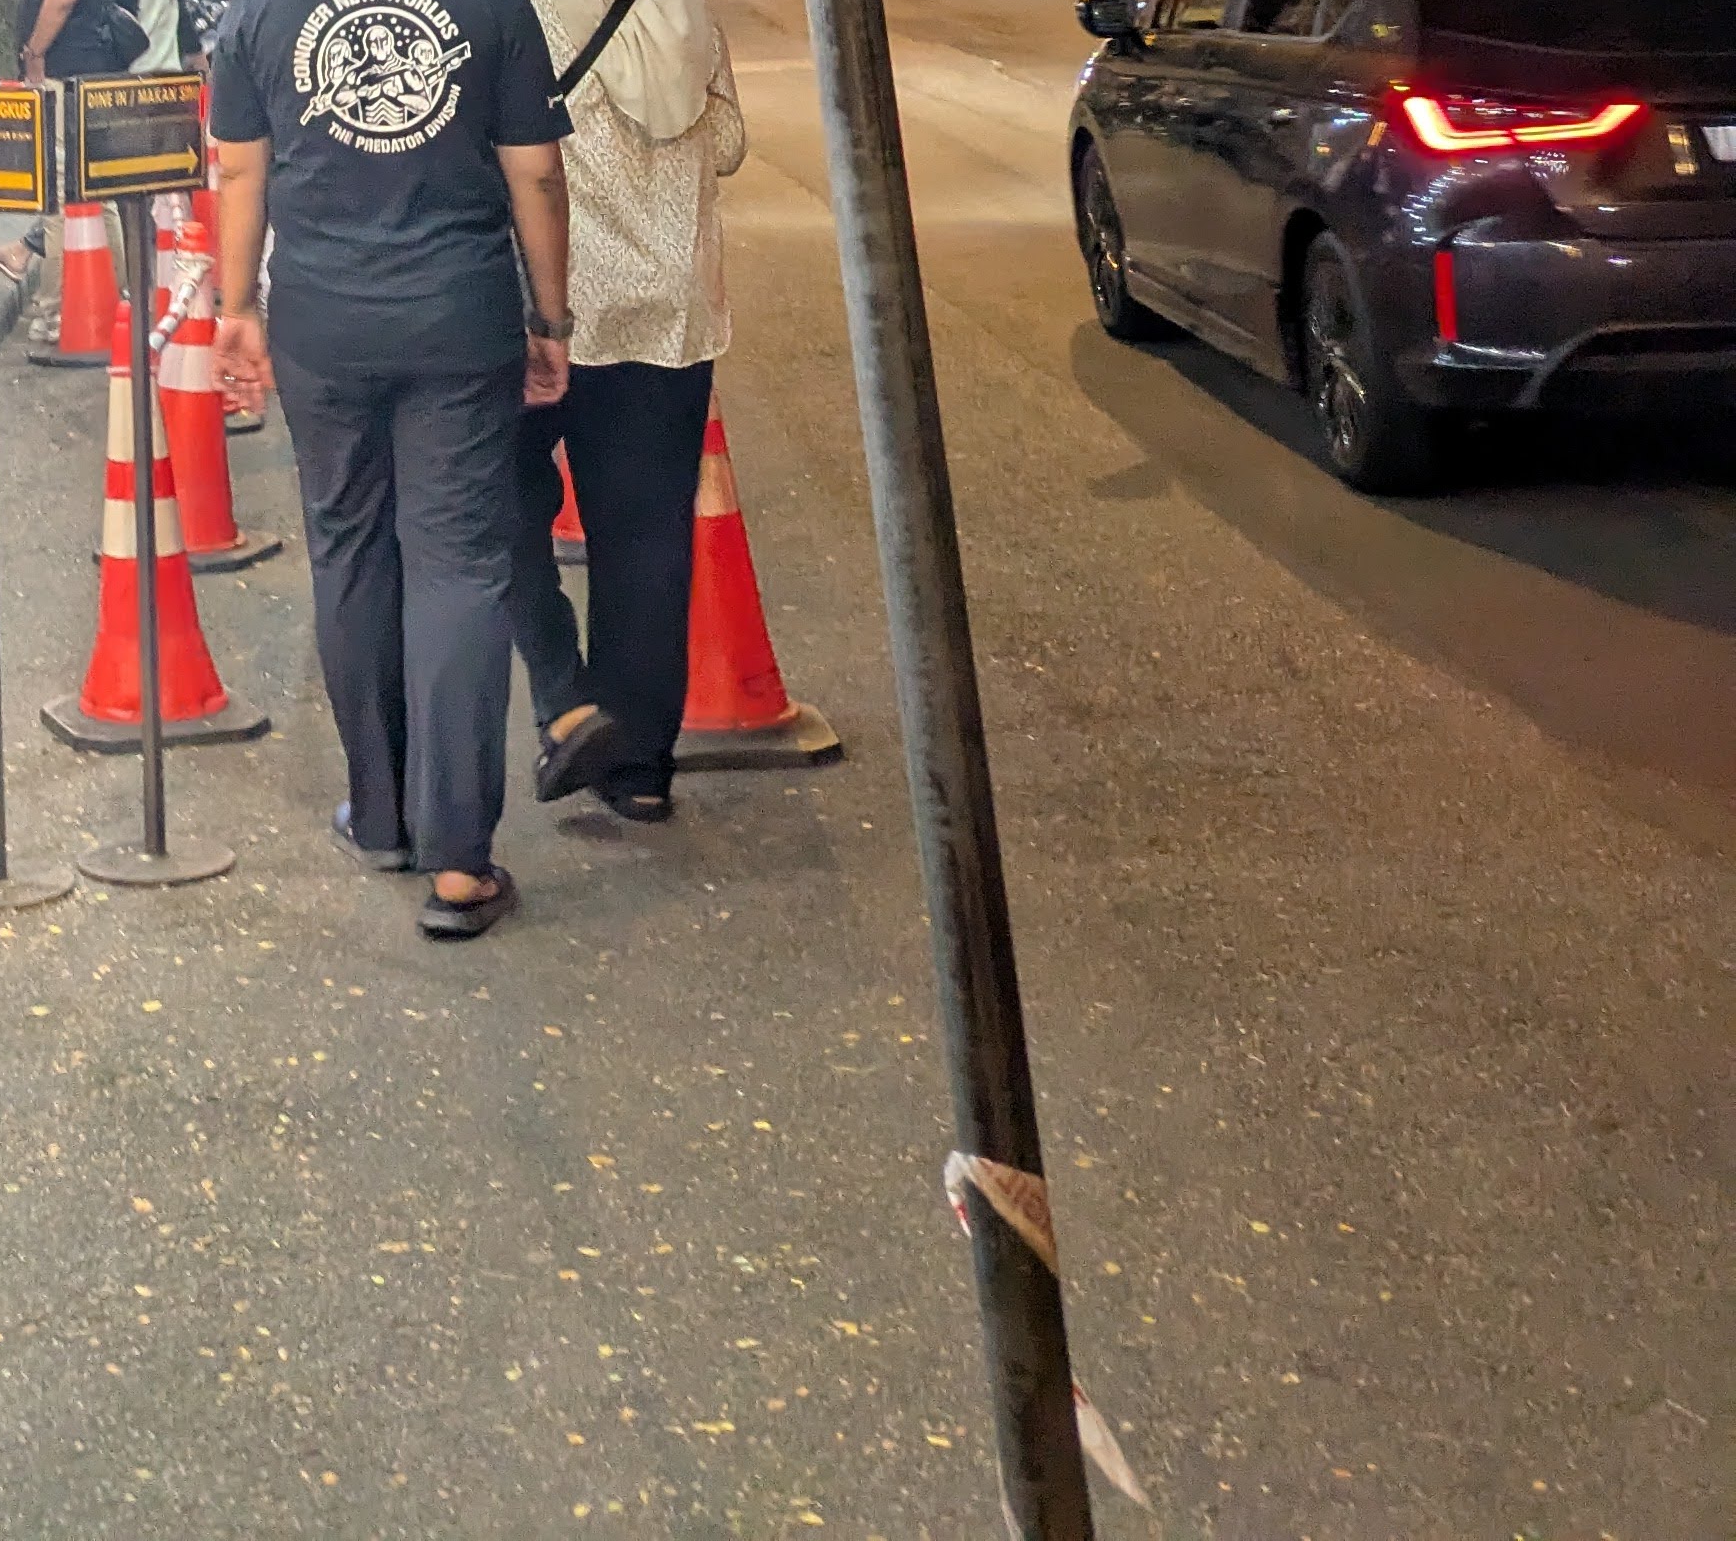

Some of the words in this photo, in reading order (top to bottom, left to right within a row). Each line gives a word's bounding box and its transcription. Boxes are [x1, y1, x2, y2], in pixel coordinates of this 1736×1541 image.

[293, 2, 335, 94] CONQUER
[328, 120, 353, 146] THE
[354, 130, 426, 154] PREDATOR
[424, 82, 462, 139] DIVISION
